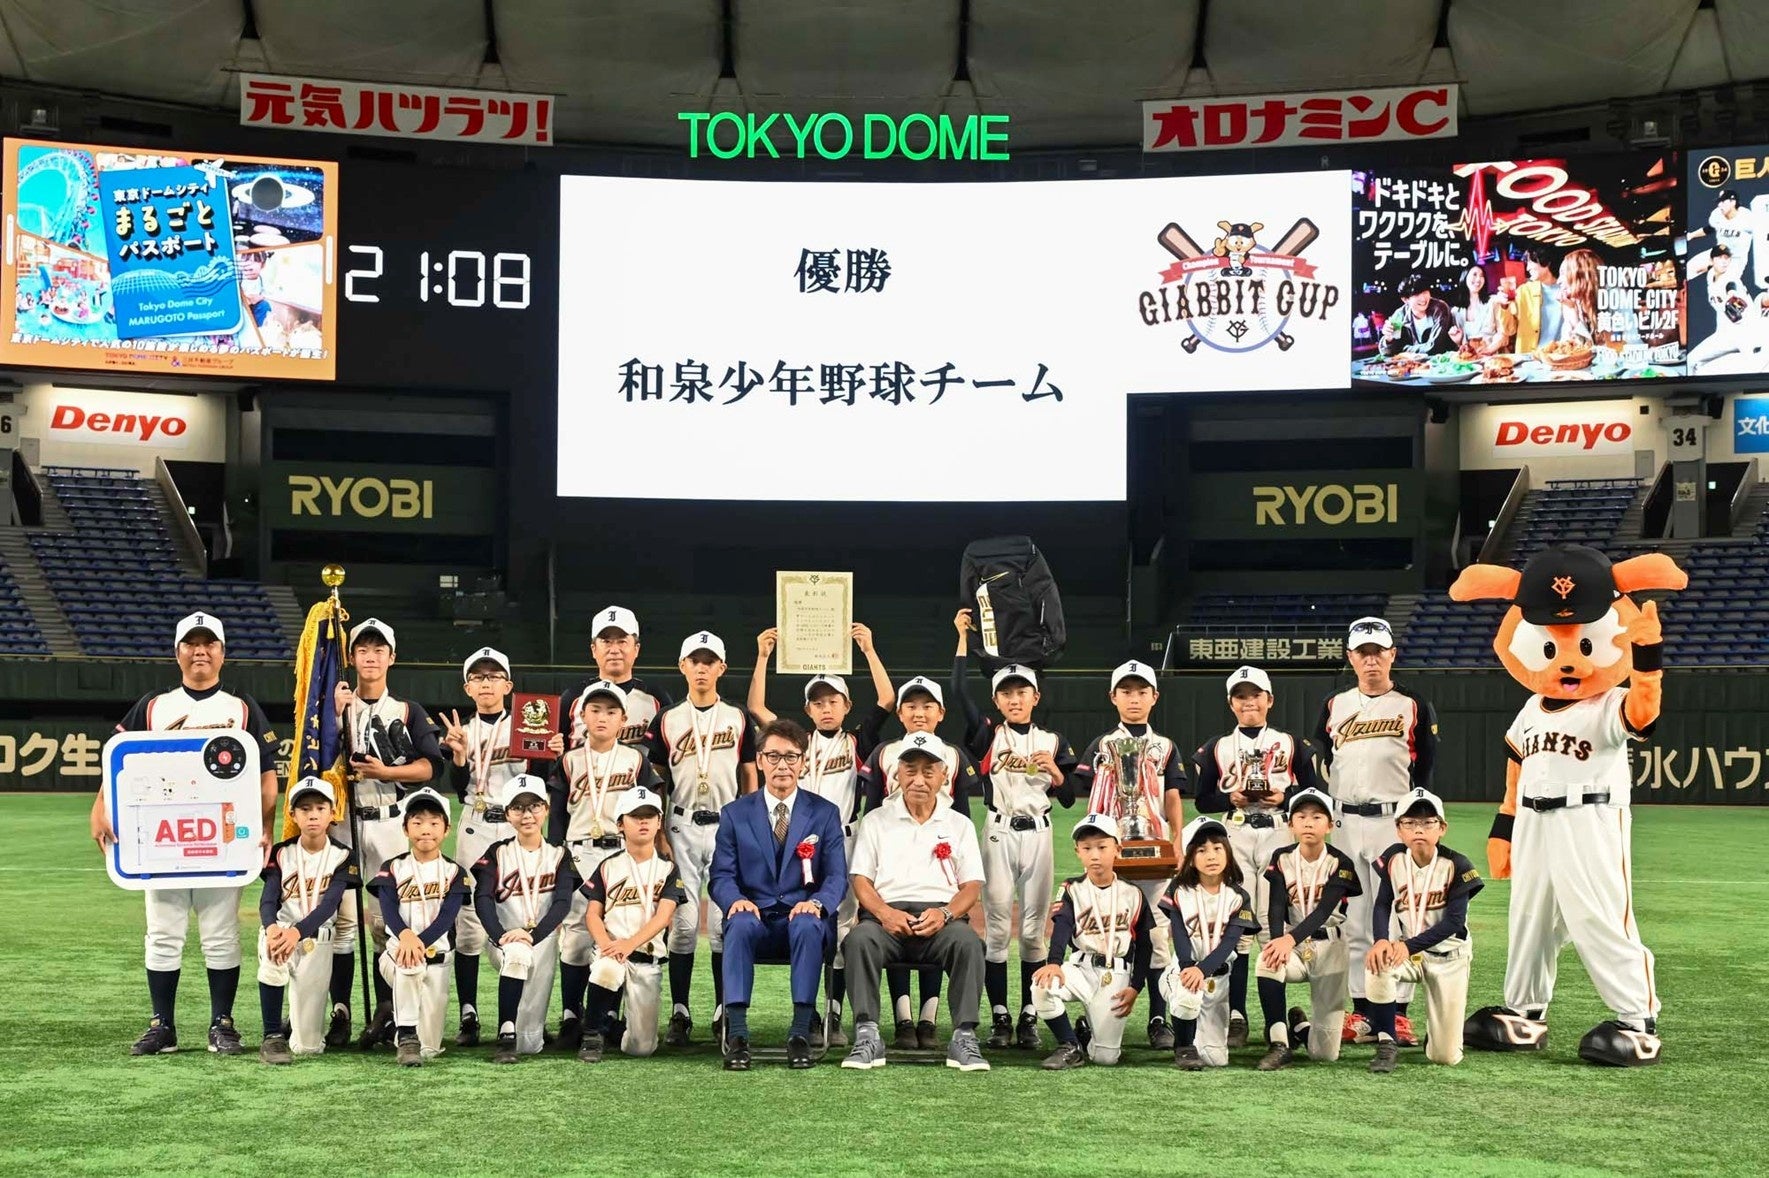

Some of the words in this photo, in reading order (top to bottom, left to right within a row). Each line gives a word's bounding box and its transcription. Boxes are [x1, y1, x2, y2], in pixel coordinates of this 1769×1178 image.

[1153, 89, 1448, 148] オロナミンC
[677, 111, 854, 160] TOKYO
[863, 113, 1010, 160] DOME
[113, 183, 209, 202] 東京ドームシティ
[1374, 177, 1461, 211] ドキドキと
[115, 200, 212, 237] まるごと
[119, 231, 216, 257] パスポート
[1373, 240, 1470, 271] テーブルに。
[793, 247, 892, 294] 優勝
[1596, 265, 1648, 288] TOKYO
[139, 301, 166, 312] Tokyo
[167, 300, 194, 309] Dome
[1139, 278, 1265, 326] GIABBIT
[1276, 280, 1340, 320] CUP
[1597, 288, 1642, 310] DOME
[1645, 288, 1678, 310] CITY
[129, 312, 185, 326] MARUGOTO
[618, 357, 1064, 406] 和泉少年野球チーム
[50, 405, 188, 441] Denyo
[1495, 421, 1632, 450] Denyo
[1672, 427, 1697, 447] 34
[288, 475, 433, 519] RYOBI
[1253, 484, 1398, 525] RYOBI
[1189, 638, 1343, 660] 東亜建設工業
[1335, 711, 1404, 751] Izumi
[1522, 732, 1593, 761] IANTS
[1628, 746, 1769, 790] 水ハウ
[155, 818, 217, 843] AED
